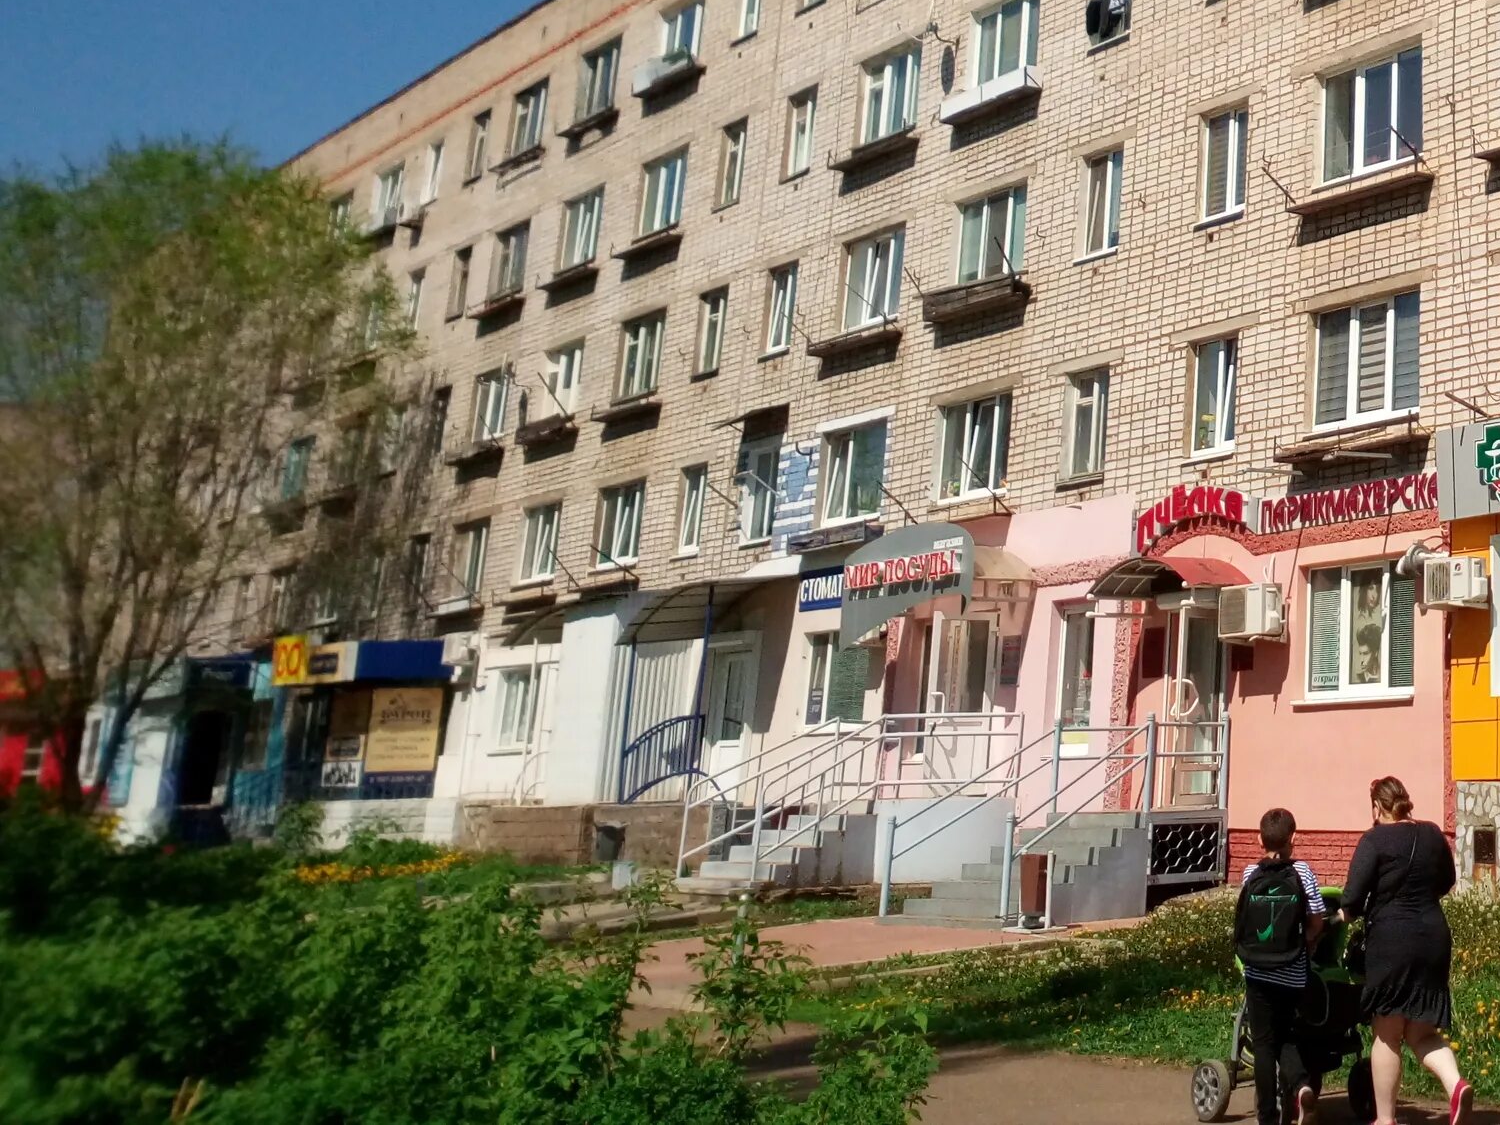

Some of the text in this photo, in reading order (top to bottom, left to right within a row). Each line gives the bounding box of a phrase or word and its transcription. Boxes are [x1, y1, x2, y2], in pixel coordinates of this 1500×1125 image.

[1137, 484, 1243, 552] ПЧЁЛКА
[801, 574, 844, 602] СТОМАТ
[844, 550, 956, 589] МИР ПОСУДЫ
